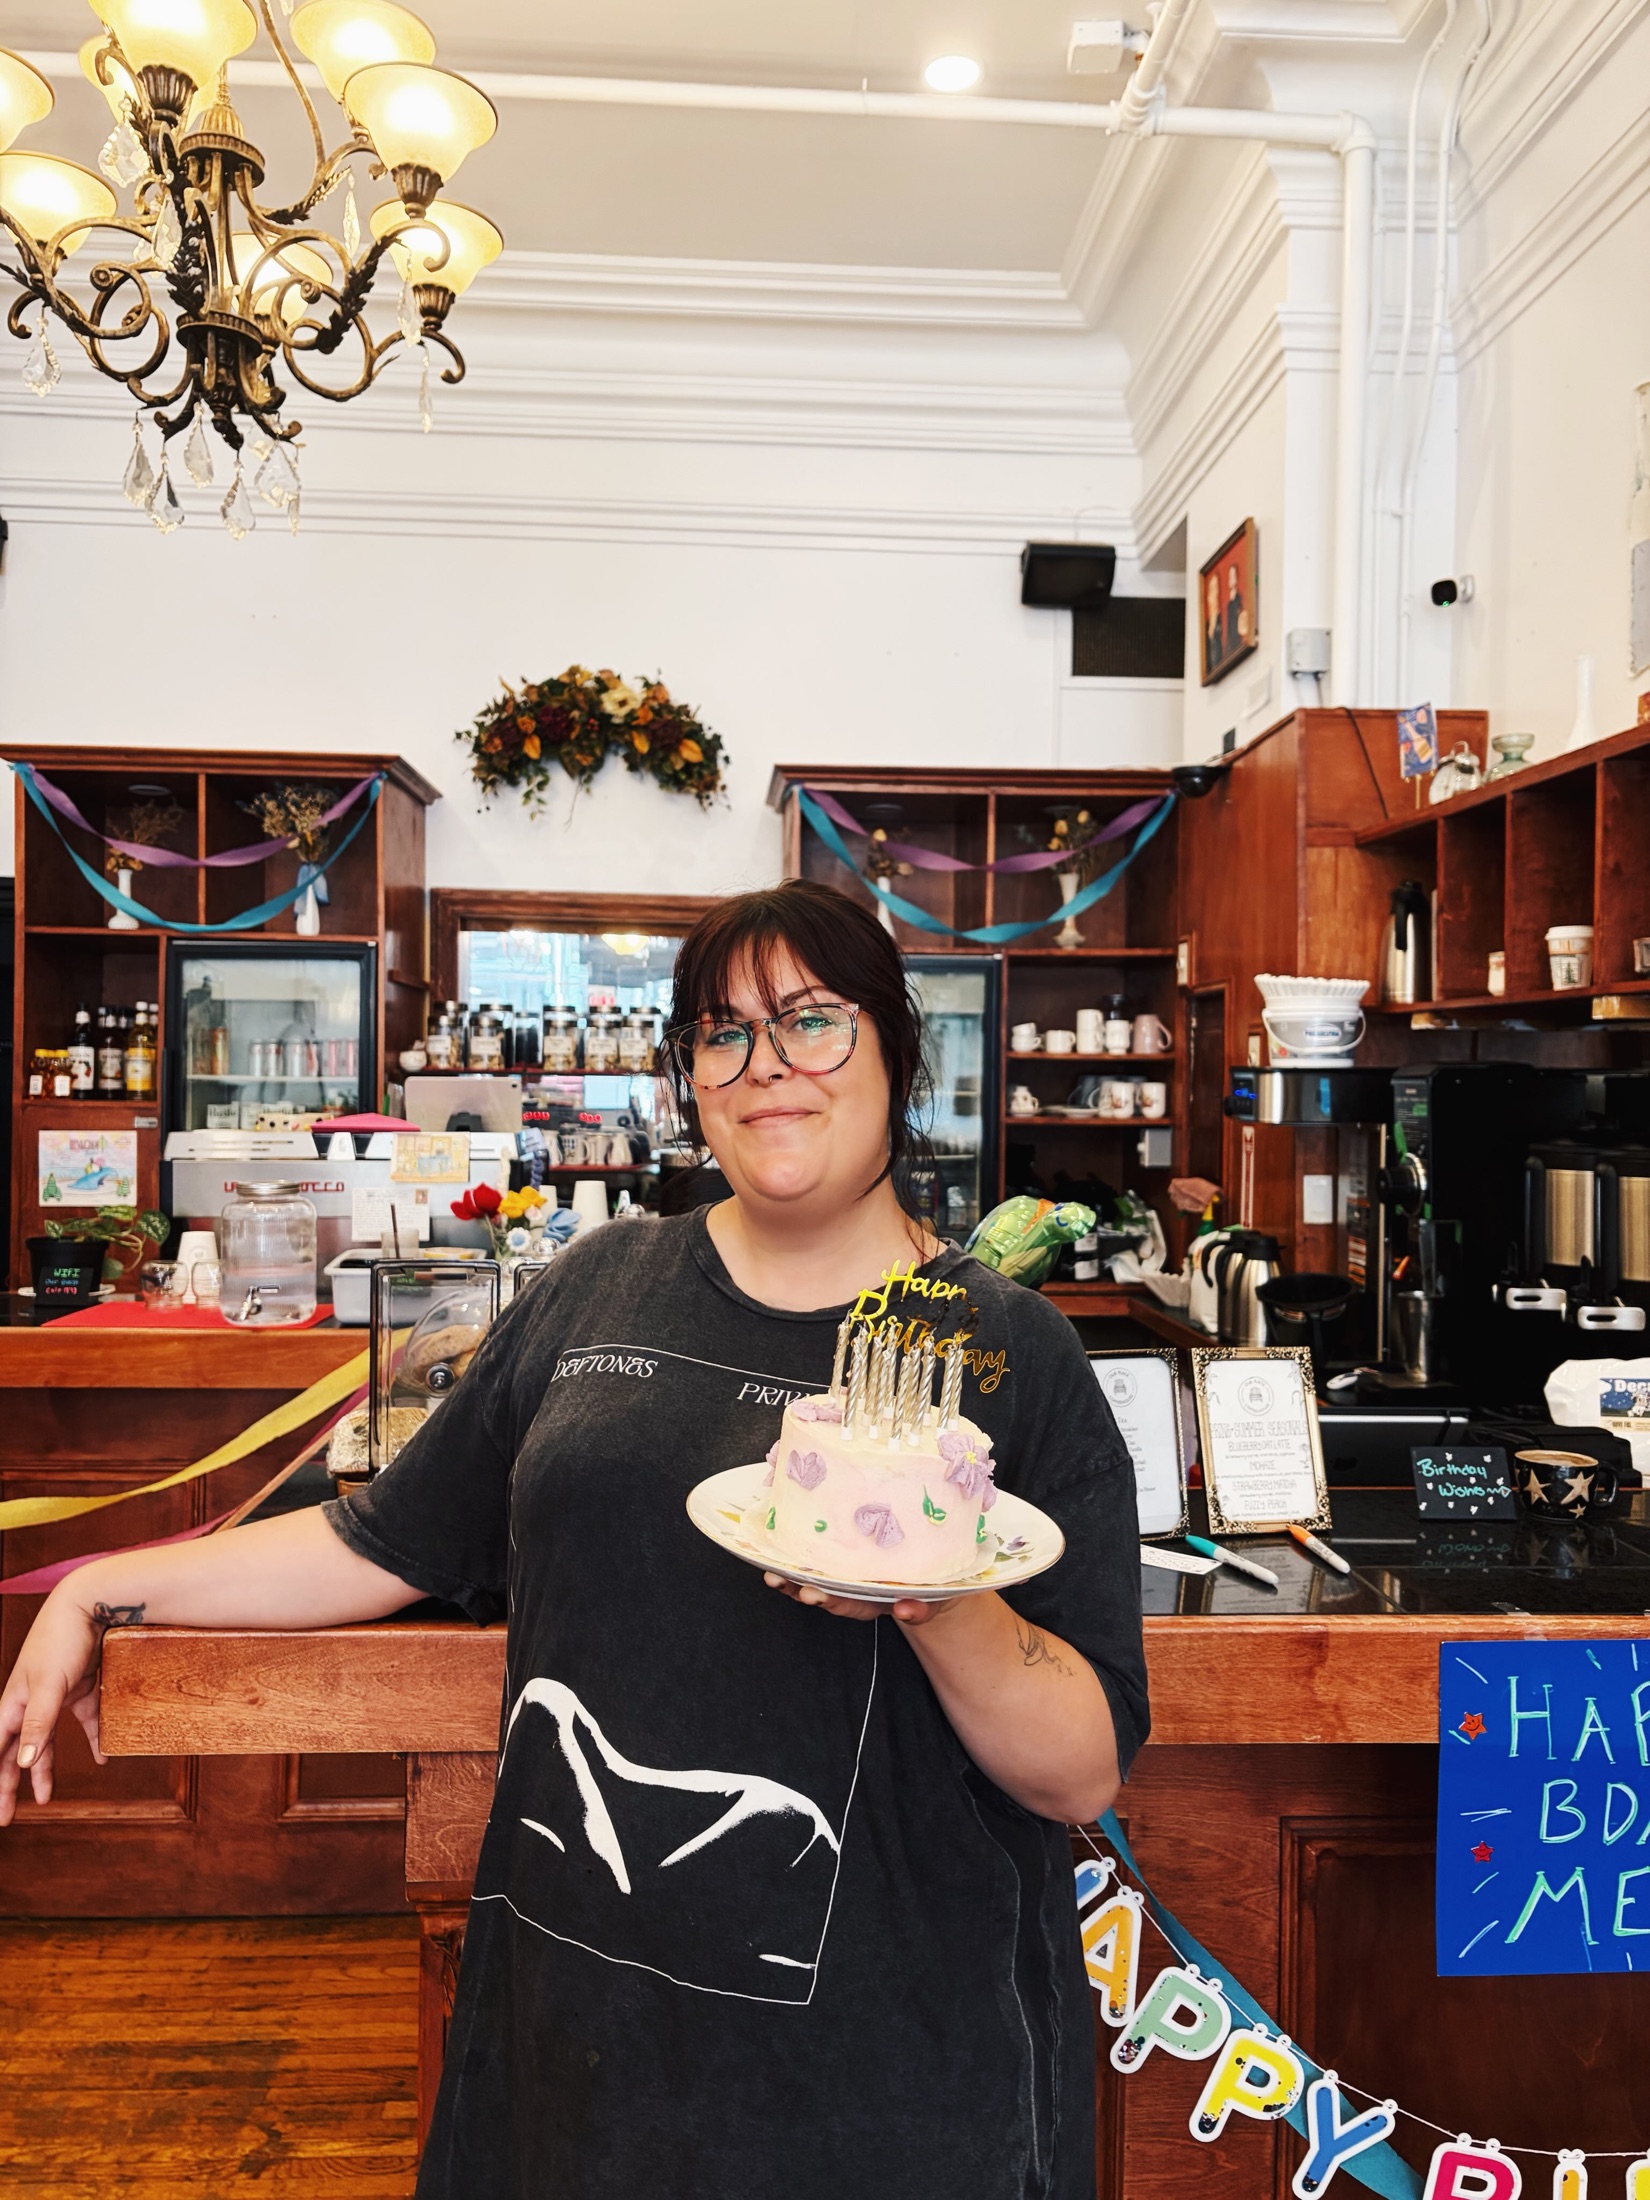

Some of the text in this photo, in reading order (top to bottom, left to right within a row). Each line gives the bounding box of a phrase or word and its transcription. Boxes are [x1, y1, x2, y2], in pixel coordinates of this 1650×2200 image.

[551, 1354, 658, 1383] DEFTONES
[736, 1382, 811, 1406] PRIV
[1614, 1379, 1650, 1393] Dec
[1417, 1458, 1487, 1479] Birthday
